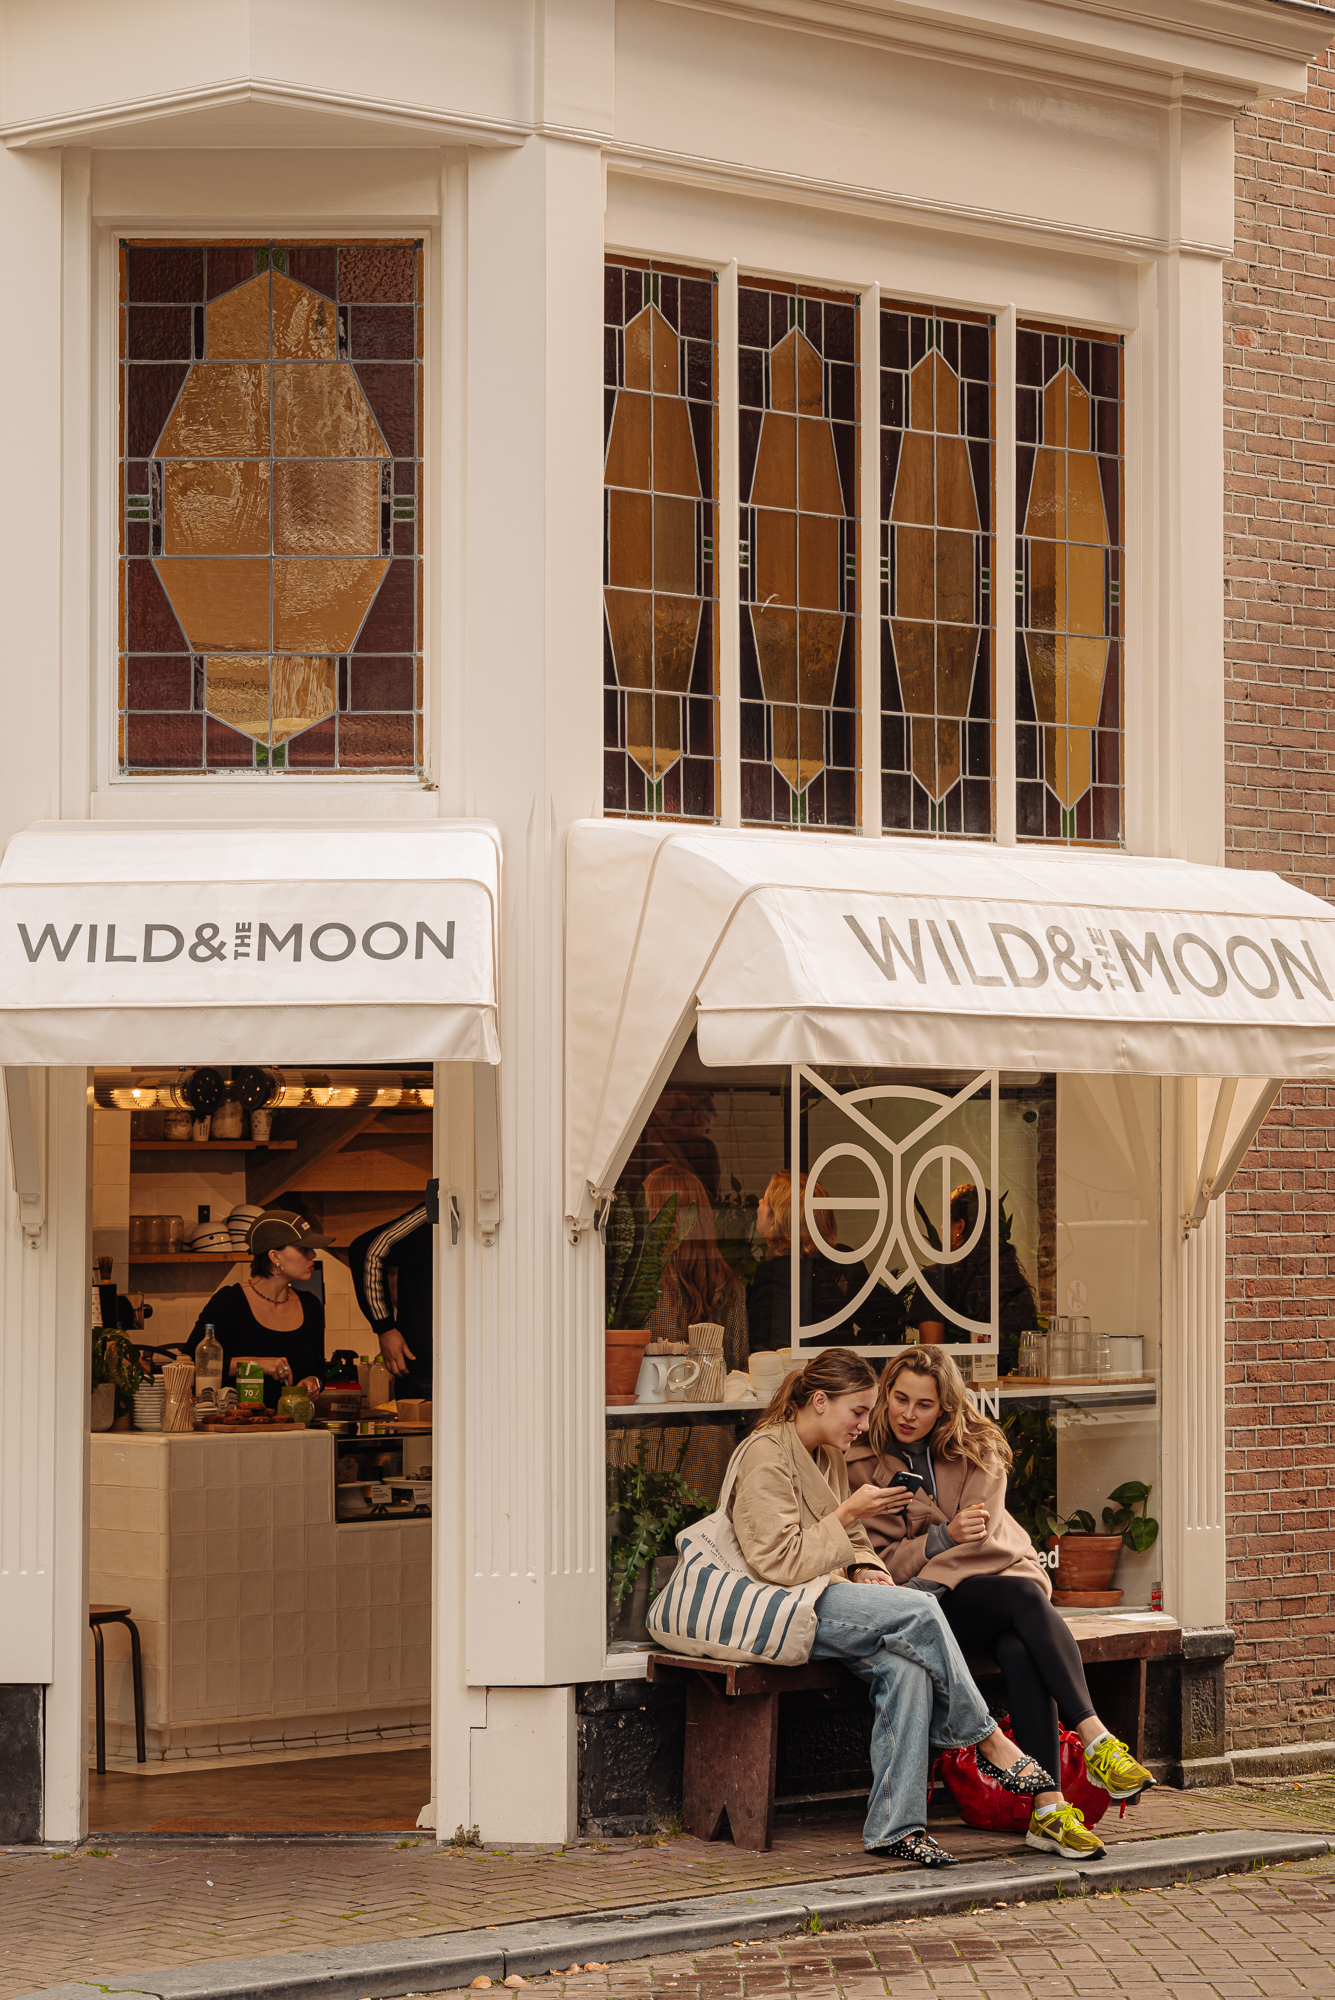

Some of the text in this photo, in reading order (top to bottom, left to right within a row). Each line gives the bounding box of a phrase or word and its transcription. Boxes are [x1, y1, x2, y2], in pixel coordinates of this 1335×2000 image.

[233, 921, 252, 960] THE
[257, 920, 456, 962] MOON
[1109, 929, 1334, 1001] MOON
